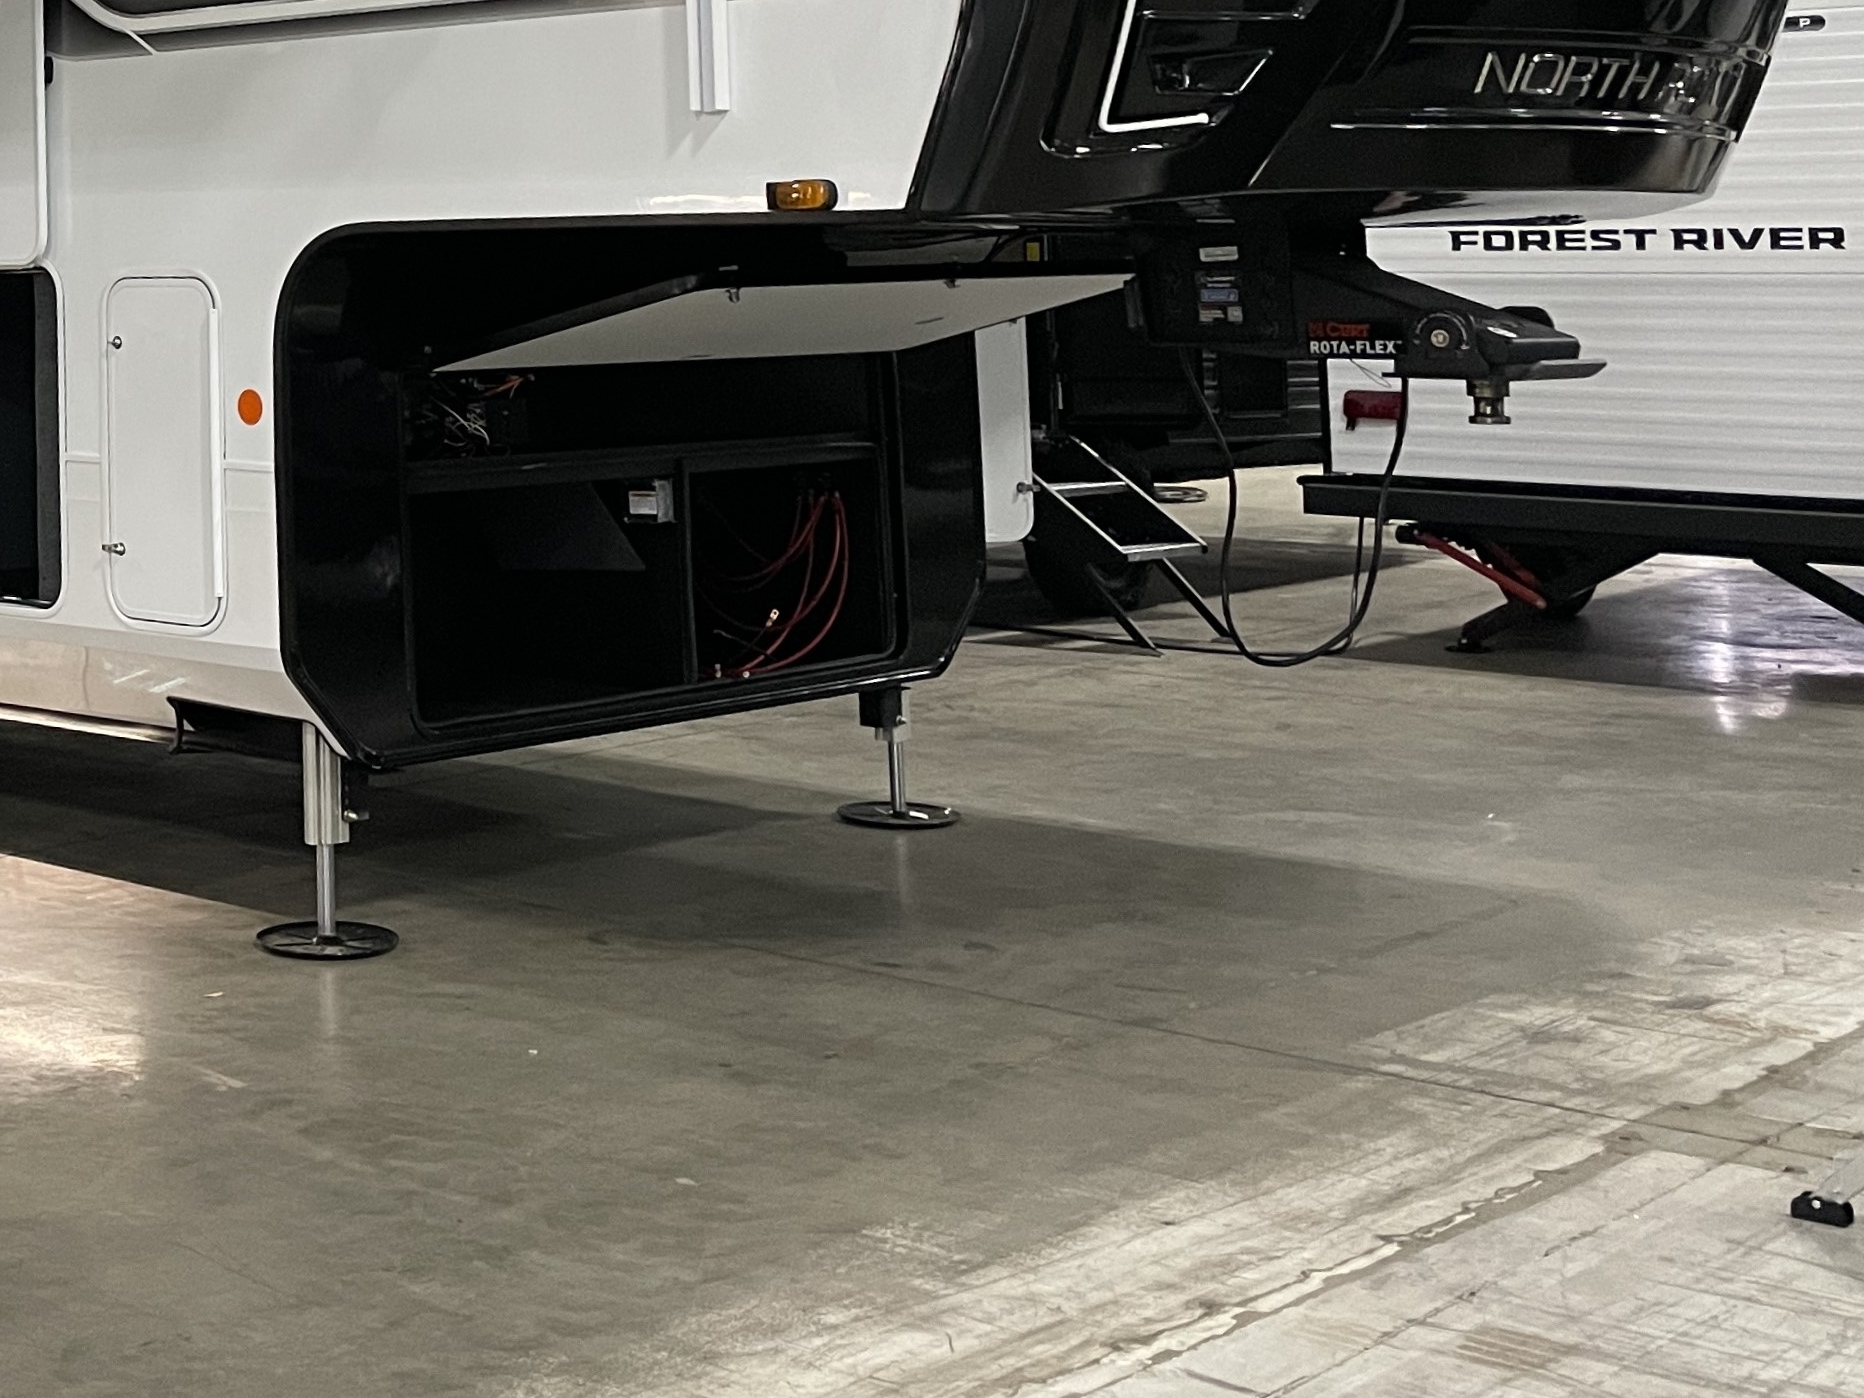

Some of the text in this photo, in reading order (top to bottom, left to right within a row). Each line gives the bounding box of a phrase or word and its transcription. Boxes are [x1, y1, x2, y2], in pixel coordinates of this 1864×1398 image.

[1473, 51, 1660, 100] NORTH
[1448, 226, 1846, 251] FOREST RIVER
